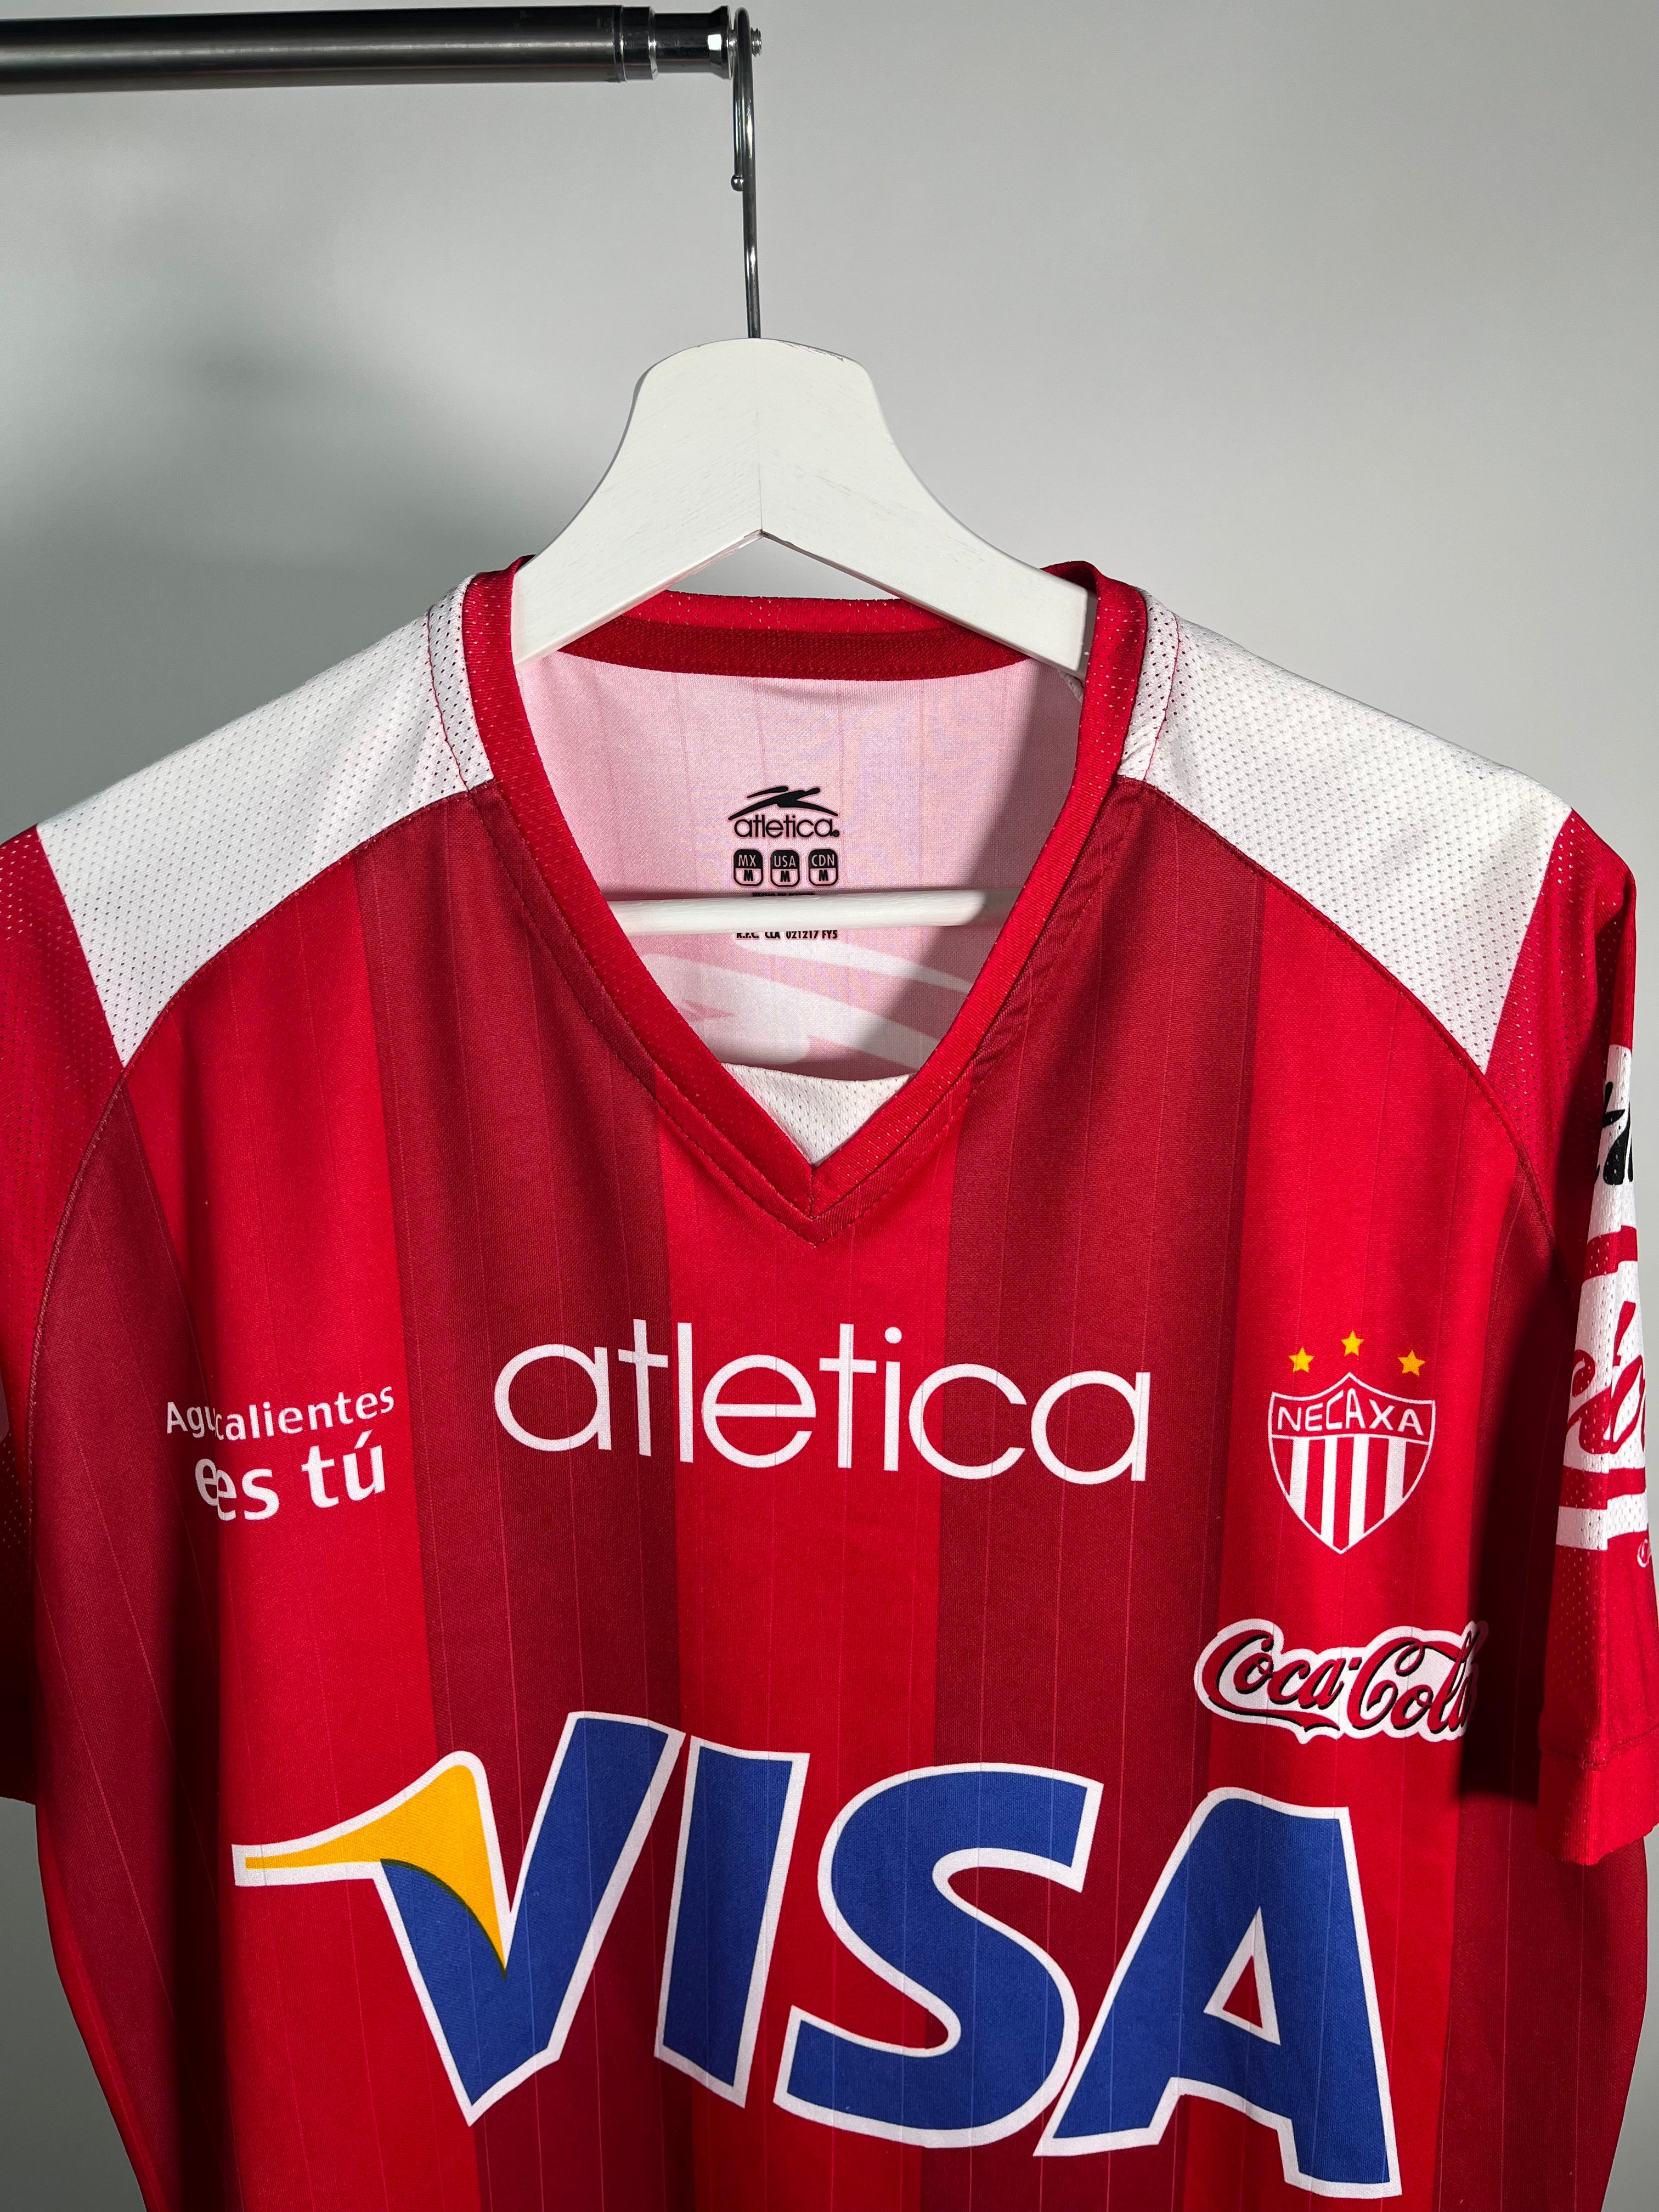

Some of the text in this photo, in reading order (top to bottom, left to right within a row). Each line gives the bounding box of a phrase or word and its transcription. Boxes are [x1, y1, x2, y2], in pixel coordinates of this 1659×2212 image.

[738, 854, 757, 867] MX
[774, 855, 796, 867] USA
[811, 854, 834, 867] CDN
[743, 870, 754, 882] M
[780, 870, 791, 882] M
[819, 869, 829, 882] M
[786, 930, 819, 939] 021217
[494, 1318, 1151, 1485] atletica
[167, 1386, 394, 1441] Agucalientes
[1277, 1388, 1424, 1436] NECAXA
[195, 1429, 386, 1521] es tú
[232, 1711, 1403, 2199] VISA
